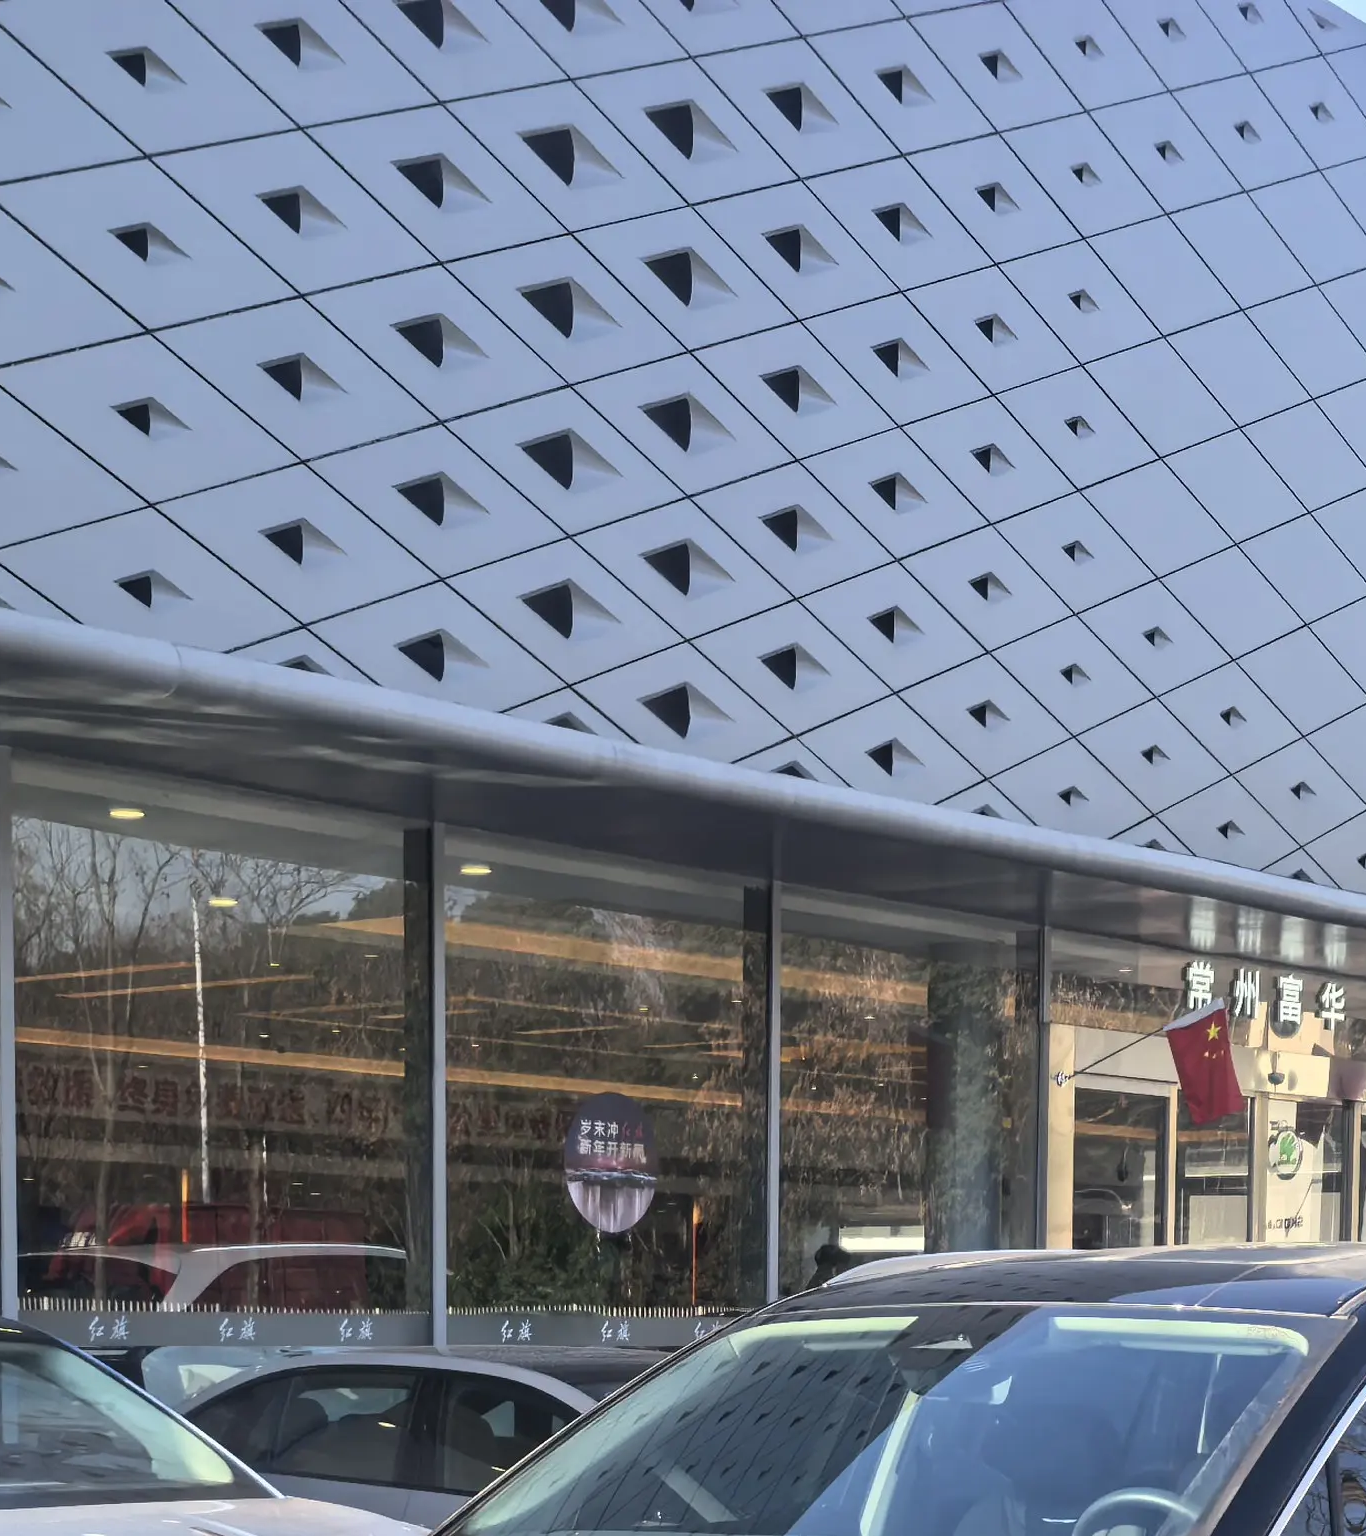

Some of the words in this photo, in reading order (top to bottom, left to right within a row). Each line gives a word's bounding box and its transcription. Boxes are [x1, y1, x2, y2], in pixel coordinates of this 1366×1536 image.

[1187, 960, 1346, 1031] 常州富华
[88, 1316, 131, 1342] 红旗
[219, 1316, 257, 1341] 红旗
[339, 1317, 375, 1342] 红旗
